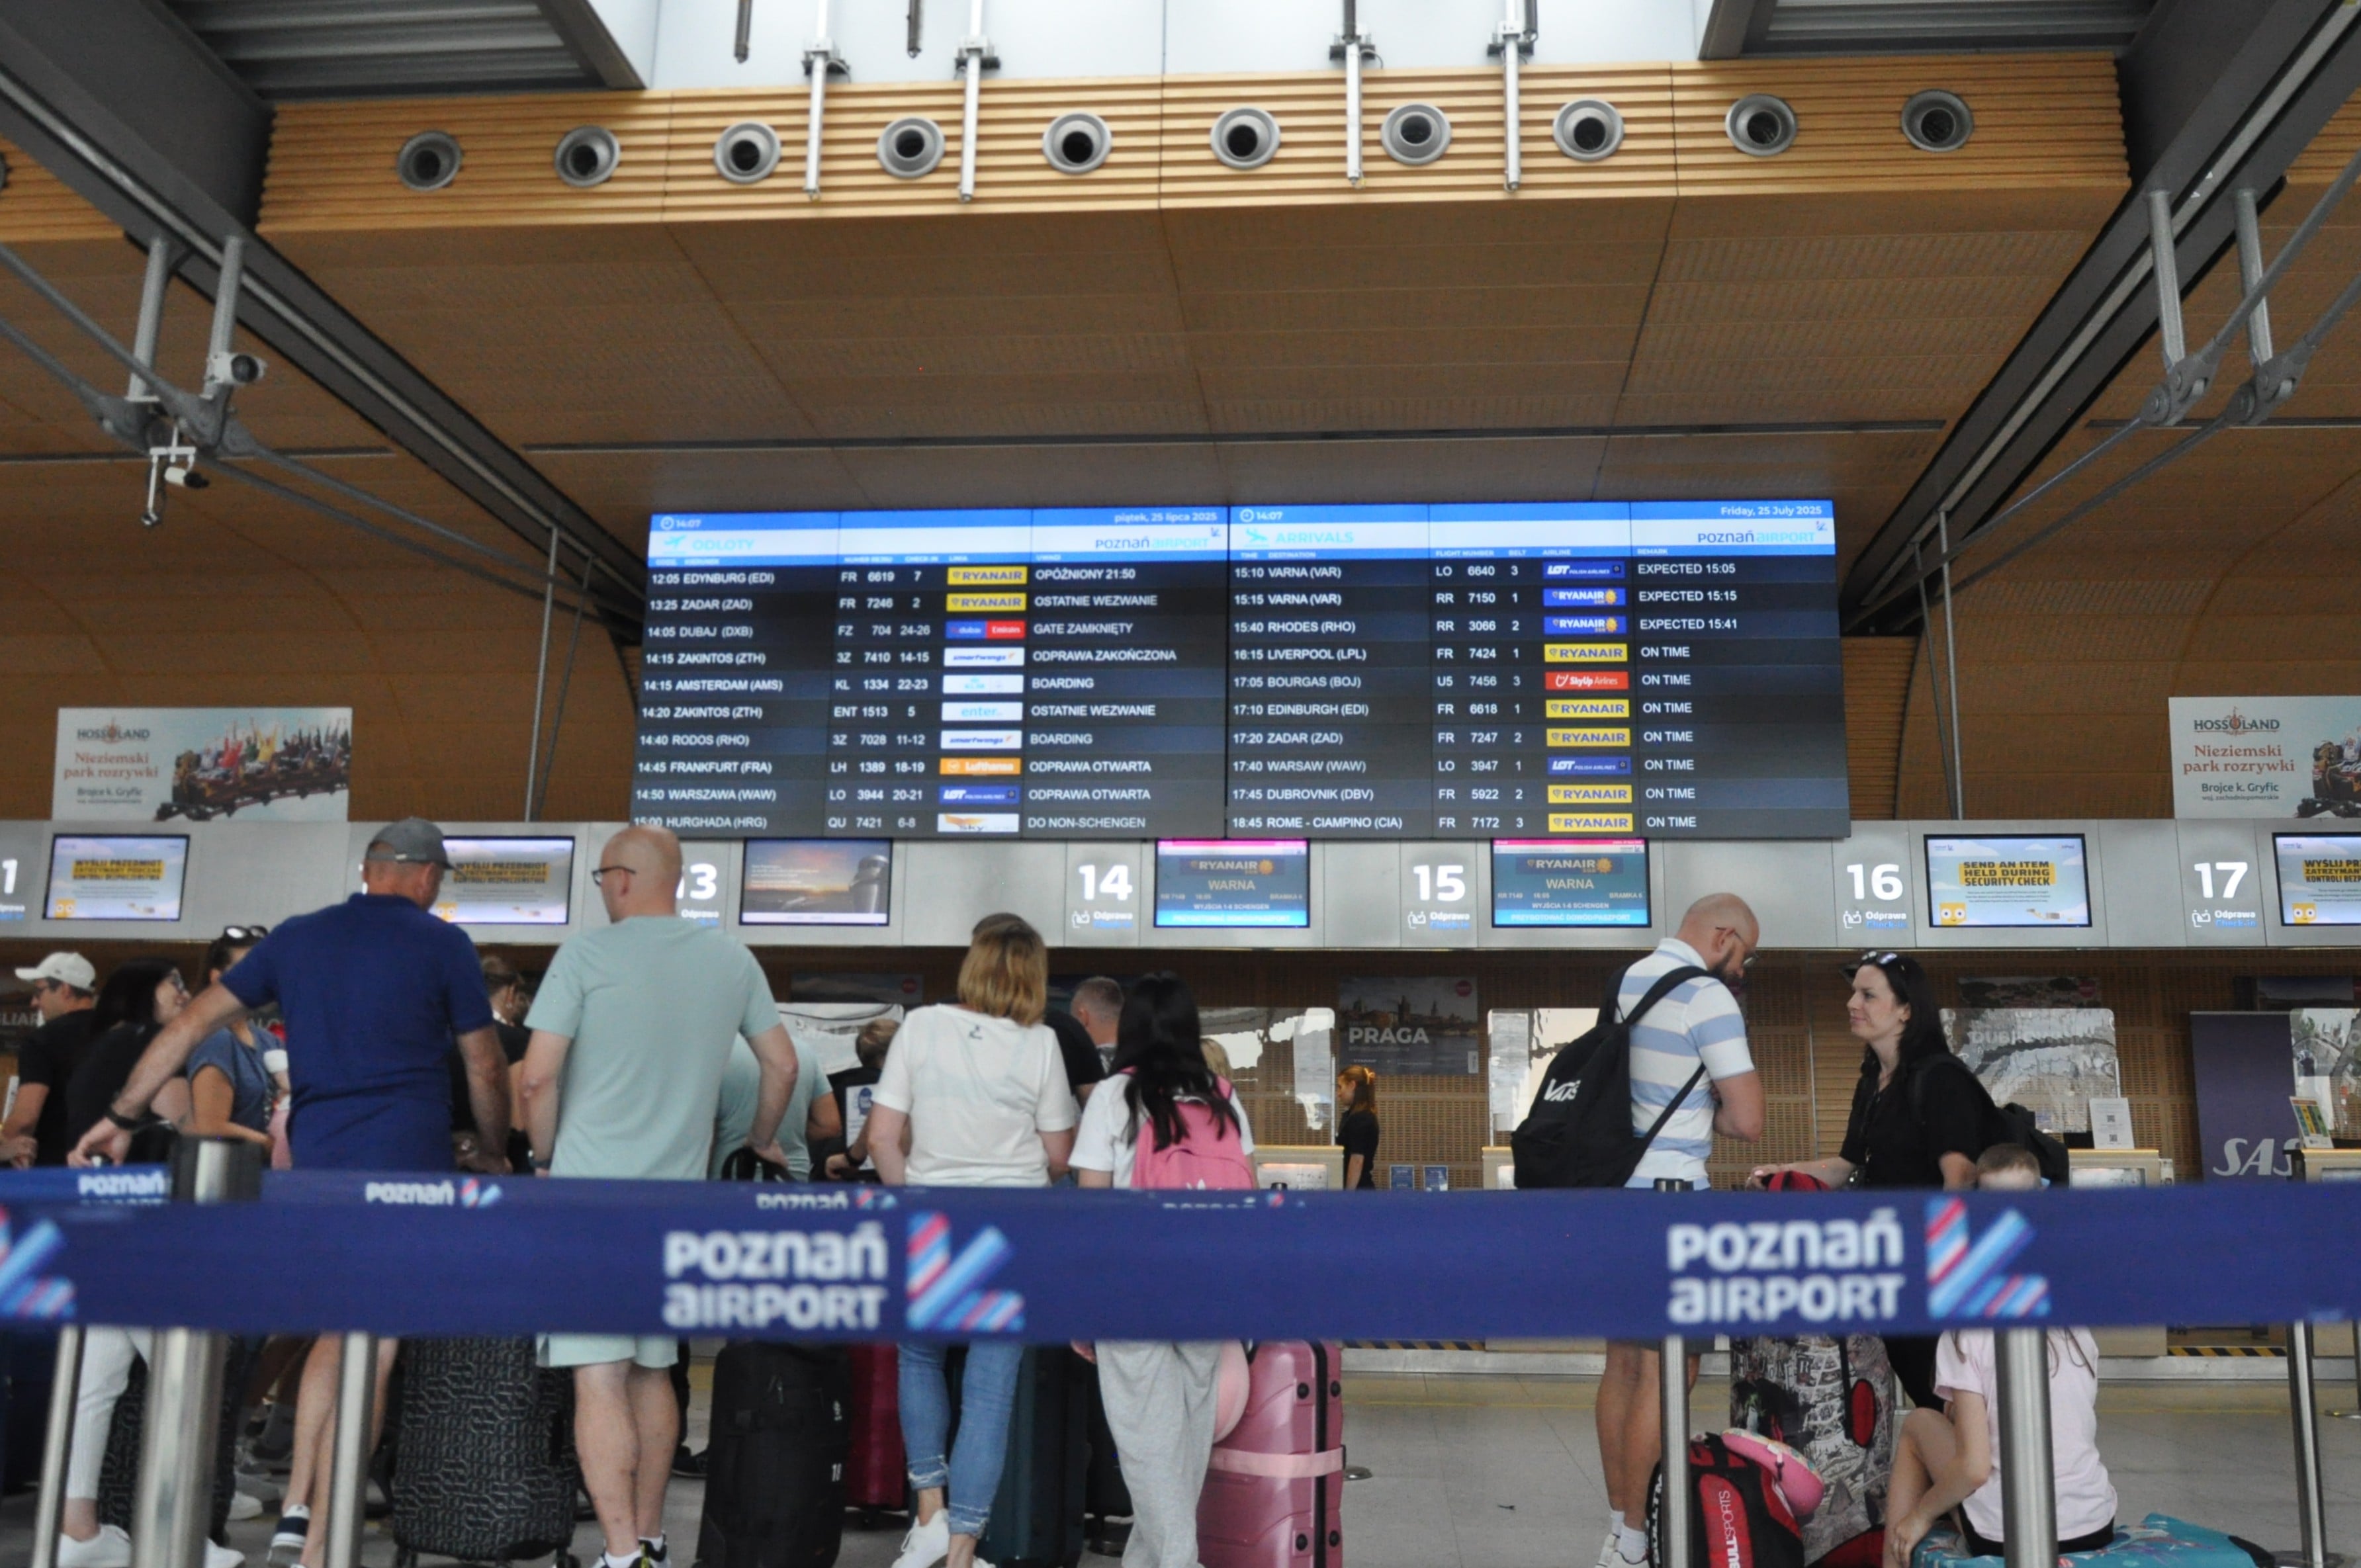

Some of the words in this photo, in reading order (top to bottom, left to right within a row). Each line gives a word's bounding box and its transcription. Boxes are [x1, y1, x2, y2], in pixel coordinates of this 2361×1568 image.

[1256, 511, 1282, 520] 14:07
[1721, 505, 1755, 517] Friday,
[1758, 506, 1769, 515] 25
[1773, 505, 1794, 517] July
[1796, 505, 1822, 515] 2025
[676, 519, 701, 528] 14:07
[1114, 513, 1148, 525] piątek,
[1165, 513, 1190, 523] lipca
[1192, 512, 1217, 521] 2025
[1275, 531, 1354, 544] ARRIVALS
[693, 539, 754, 550] ODLOTY
[1035, 569, 1103, 580] OPÓŹNIONY
[1105, 568, 1136, 580] 21:50
[1268, 568, 1309, 578] VARNA
[1310, 567, 1342, 579] (VAR)
[1638, 564, 1703, 574] EXPECTED
[1706, 563, 1736, 574] 15:05
[683, 574, 746, 584] EDYNBURG
[748, 573, 775, 585] (EDI)
[962, 571, 1022, 580] RYANAIR
[1034, 595, 1091, 607] OSTATNIE
[1092, 595, 1158, 606] WEZWANIE
[1268, 593, 1309, 605] VARNA
[1310, 593, 1342, 606] (VAR)
[1638, 590, 1704, 601] EXPECTED
[1707, 590, 1737, 601] 15:15
[681, 599, 720, 611] ZADAR
[721, 599, 753, 611] (ZAD)
[961, 597, 1021, 607] RYANAIR
[1033, 623, 1065, 634] GATE
[1066, 623, 1134, 635] ZAMKNIĘTY
[1268, 621, 1319, 632] RHODES
[1321, 621, 1356, 634] (RHO)
[1640, 619, 1705, 630] EXPECTED
[1708, 618, 1737, 629] 15:41
[679, 626, 717, 638] DUBAJ
[721, 626, 753, 638] (DXB)
[1032, 650, 1094, 662] ODPRAWA
[1094, 648, 1177, 662] ZAKOŃCZONA
[1267, 648, 1335, 660] LIVERPOOL
[1336, 648, 1367, 661] (LPL)
[1560, 648, 1623, 658] RYANAIR
[1640, 646, 1659, 658] ON
[1662, 646, 1690, 657] TIME
[677, 652, 734, 664] ZAKINTOS
[735, 652, 766, 665] (ZTH)
[675, 679, 748, 691] AMSTERDAM
[750, 679, 783, 692] (AMS)
[1032, 677, 1094, 689] BOARDING
[1267, 676, 1327, 687] BOURGAS
[1329, 676, 1361, 689] (BOJ)
[1642, 674, 1660, 685] ON
[1664, 674, 1691, 685] TIME
[673, 707, 730, 719] ZAKINTOS
[732, 706, 763, 719] (ZTH)
[1030, 705, 1088, 717] OSTATNIE
[1090, 705, 1156, 716] WEZWANIE
[1267, 704, 1339, 715] EDINBURGH
[1341, 704, 1369, 717] (EDI)
[1642, 702, 1661, 713] ON
[1664, 702, 1693, 713] TIME
[672, 734, 714, 746] RODOS
[715, 734, 750, 747] (RHO)
[1030, 733, 1093, 745] BOARDING
[1267, 732, 1308, 744] ZADAR
[1310, 732, 1343, 745] (ZAD)
[1643, 731, 1662, 742] ON
[1664, 731, 1693, 742] TIME
[2194, 745, 2282, 757] Nieziemski
[670, 761, 739, 773] FRANKFURT
[740, 761, 772, 774] (FRA)
[1029, 761, 1092, 772] ODPRAWA
[1093, 761, 1151, 772] OTWARTA
[1267, 761, 1324, 771] WARSAW
[1326, 760, 1366, 773] (WAW)
[1644, 760, 1663, 770] ON
[1666, 760, 1694, 770] TIME
[2184, 760, 2219, 775] park
[2224, 760, 2295, 774] rozrywki
[64, 767, 93, 780] park
[98, 766, 157, 779] rozrywki
[1646, 788, 1664, 799] ON
[1667, 788, 1695, 799] TIME
[2202, 783, 2233, 794] Brojce
[2237, 783, 2245, 792] k.
[2248, 782, 2279, 793] Gryfic
[668, 789, 736, 801] WARSZAWA
[738, 789, 777, 802] (WAW)
[1028, 789, 1092, 800] ODPRAWA
[1092, 789, 1151, 800] OTWARTA
[1267, 789, 1338, 800] DUBROVNIK
[1341, 789, 1374, 801] (DBV)
[666, 816, 732, 828] HURGHADA
[733, 816, 768, 830] (HRG)
[1028, 817, 1046, 828] DO
[1048, 817, 1145, 828] NON-SCHENGEN
[1267, 817, 1303, 828] ROME
[1313, 817, 1372, 828] CIAMPINO
[1374, 817, 1402, 830] (CIA)
[1564, 818, 1628, 828] RYANAIR
[1646, 816, 1665, 827] ON
[1668, 816, 1697, 827] TIME
[1199, 861, 1257, 870] RYANAIR
[1536, 859, 1595, 869] RYANAIR
[2304, 859, 2342, 867] WYŚLIJ
[2001, 868, 2050, 877] DURING
[1079, 864, 1133, 900] 14
[1208, 880, 1255, 891] WARNA
[1413, 864, 1466, 901] 15
[1546, 879, 1594, 889] WARNA
[1847, 863, 1903, 900] 16
[1965, 877, 2014, 887] SECURITY
[2017, 877, 2051, 886] CHECK
[2194, 862, 2249, 898] 17
[1430, 911, 1470, 921] Odprawa
[1865, 911, 1906, 921] Odprawa
[2214, 910, 2256, 920] Odprawa
[1349, 1027, 1429, 1043] PRAGA
